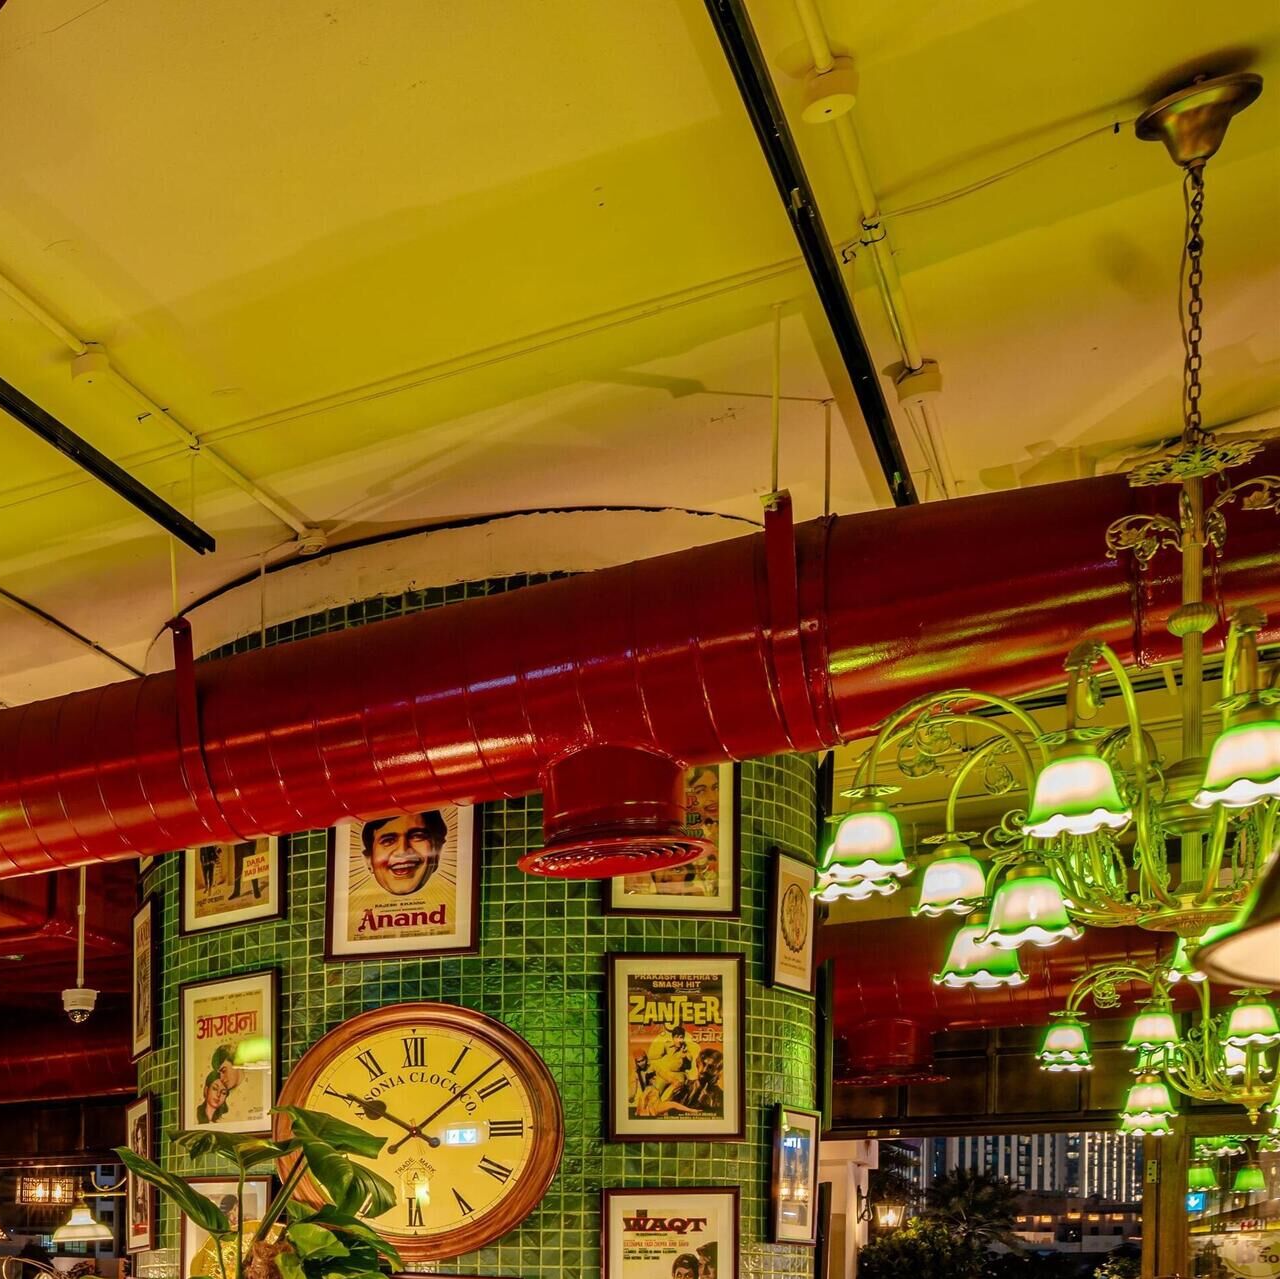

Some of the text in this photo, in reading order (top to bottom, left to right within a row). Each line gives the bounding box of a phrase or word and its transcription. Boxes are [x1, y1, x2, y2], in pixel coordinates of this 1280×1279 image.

[358, 904, 447, 932] Anand
[196, 1010, 258, 1039] आराधना
[629, 995, 723, 1030] ZANJEER
[401, 1037, 428, 1068] XII
[354, 1072, 405, 1120] ASONIA
[409, 1072, 462, 1096] CLOCK
[394, 1157, 437, 1176] TRADE MARK
[412, 1172, 420, 1181] A
[623, 1217, 707, 1234] WAQT
